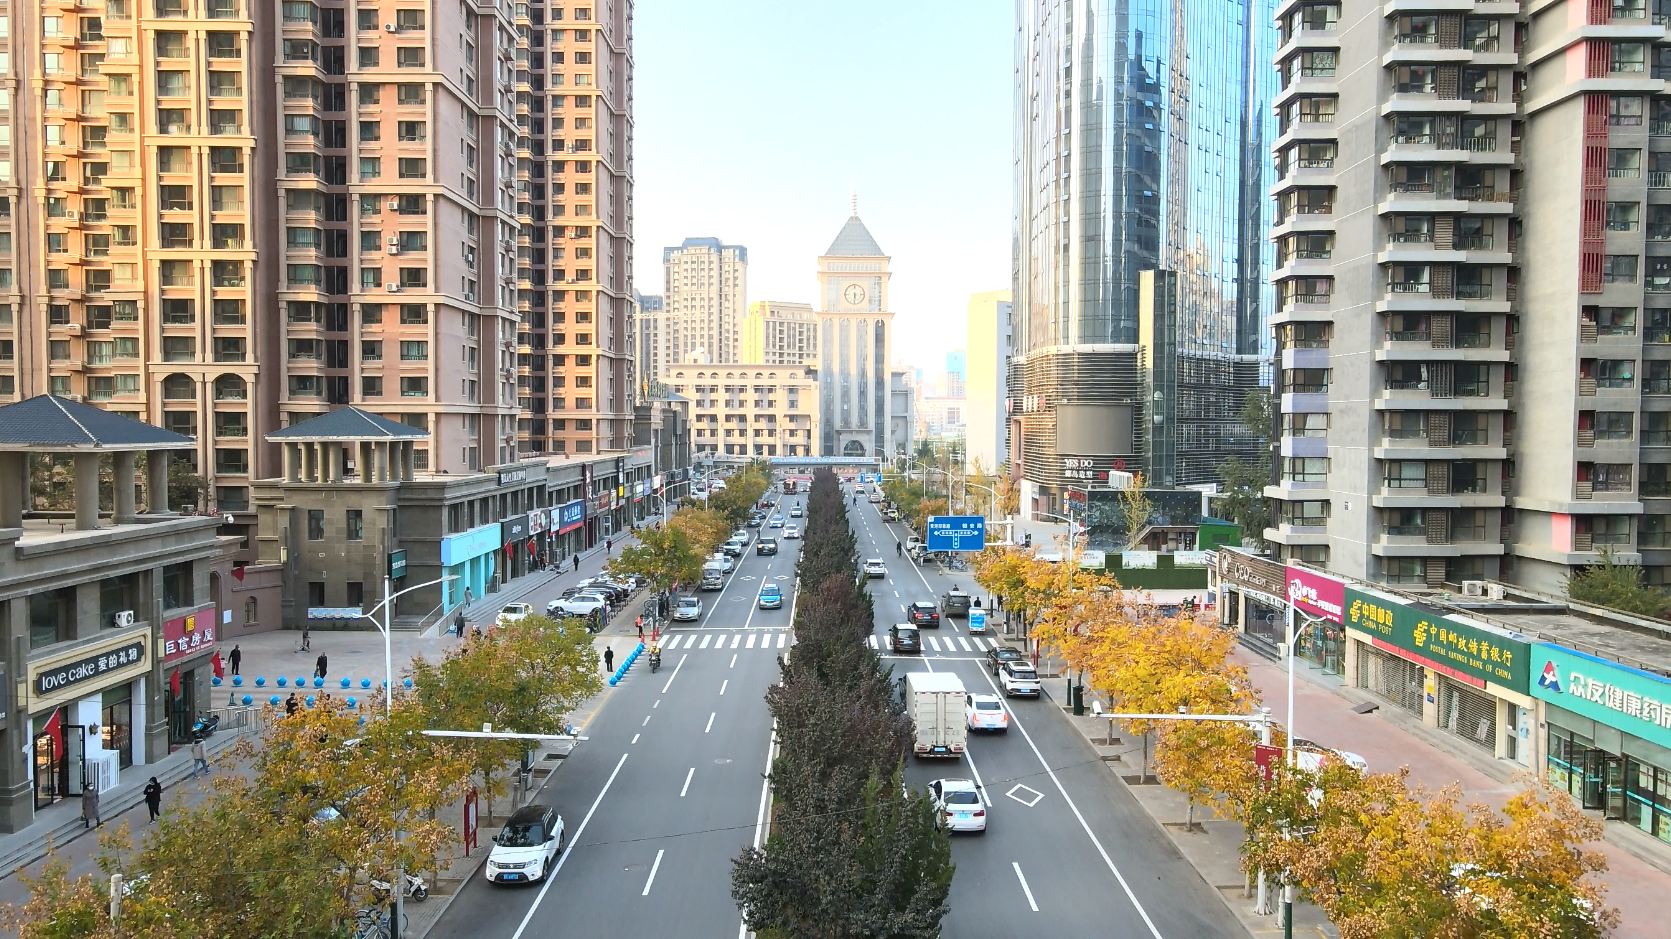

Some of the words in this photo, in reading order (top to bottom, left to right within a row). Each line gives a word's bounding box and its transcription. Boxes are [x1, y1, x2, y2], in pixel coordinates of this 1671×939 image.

[1361, 618, 1377, 630] CHINA
[1378, 624, 1392, 636] POST
[1362, 602, 1393, 628] 中国邮政
[165, 628, 213, 655] 巨信房屋
[1430, 623, 1512, 667] 中国邮政储蓄银行
[98, 648, 137, 672] 爱的礼物
[1430, 644, 1447, 656] POSTAL
[1448, 651, 1468, 664] SAVINGS
[1469, 658, 1483, 670] BANK
[1485, 664, 1493, 673] OF
[1495, 667, 1512, 681] CHINA
[42, 672, 67, 691] love
[68, 663, 96, 682] cake
